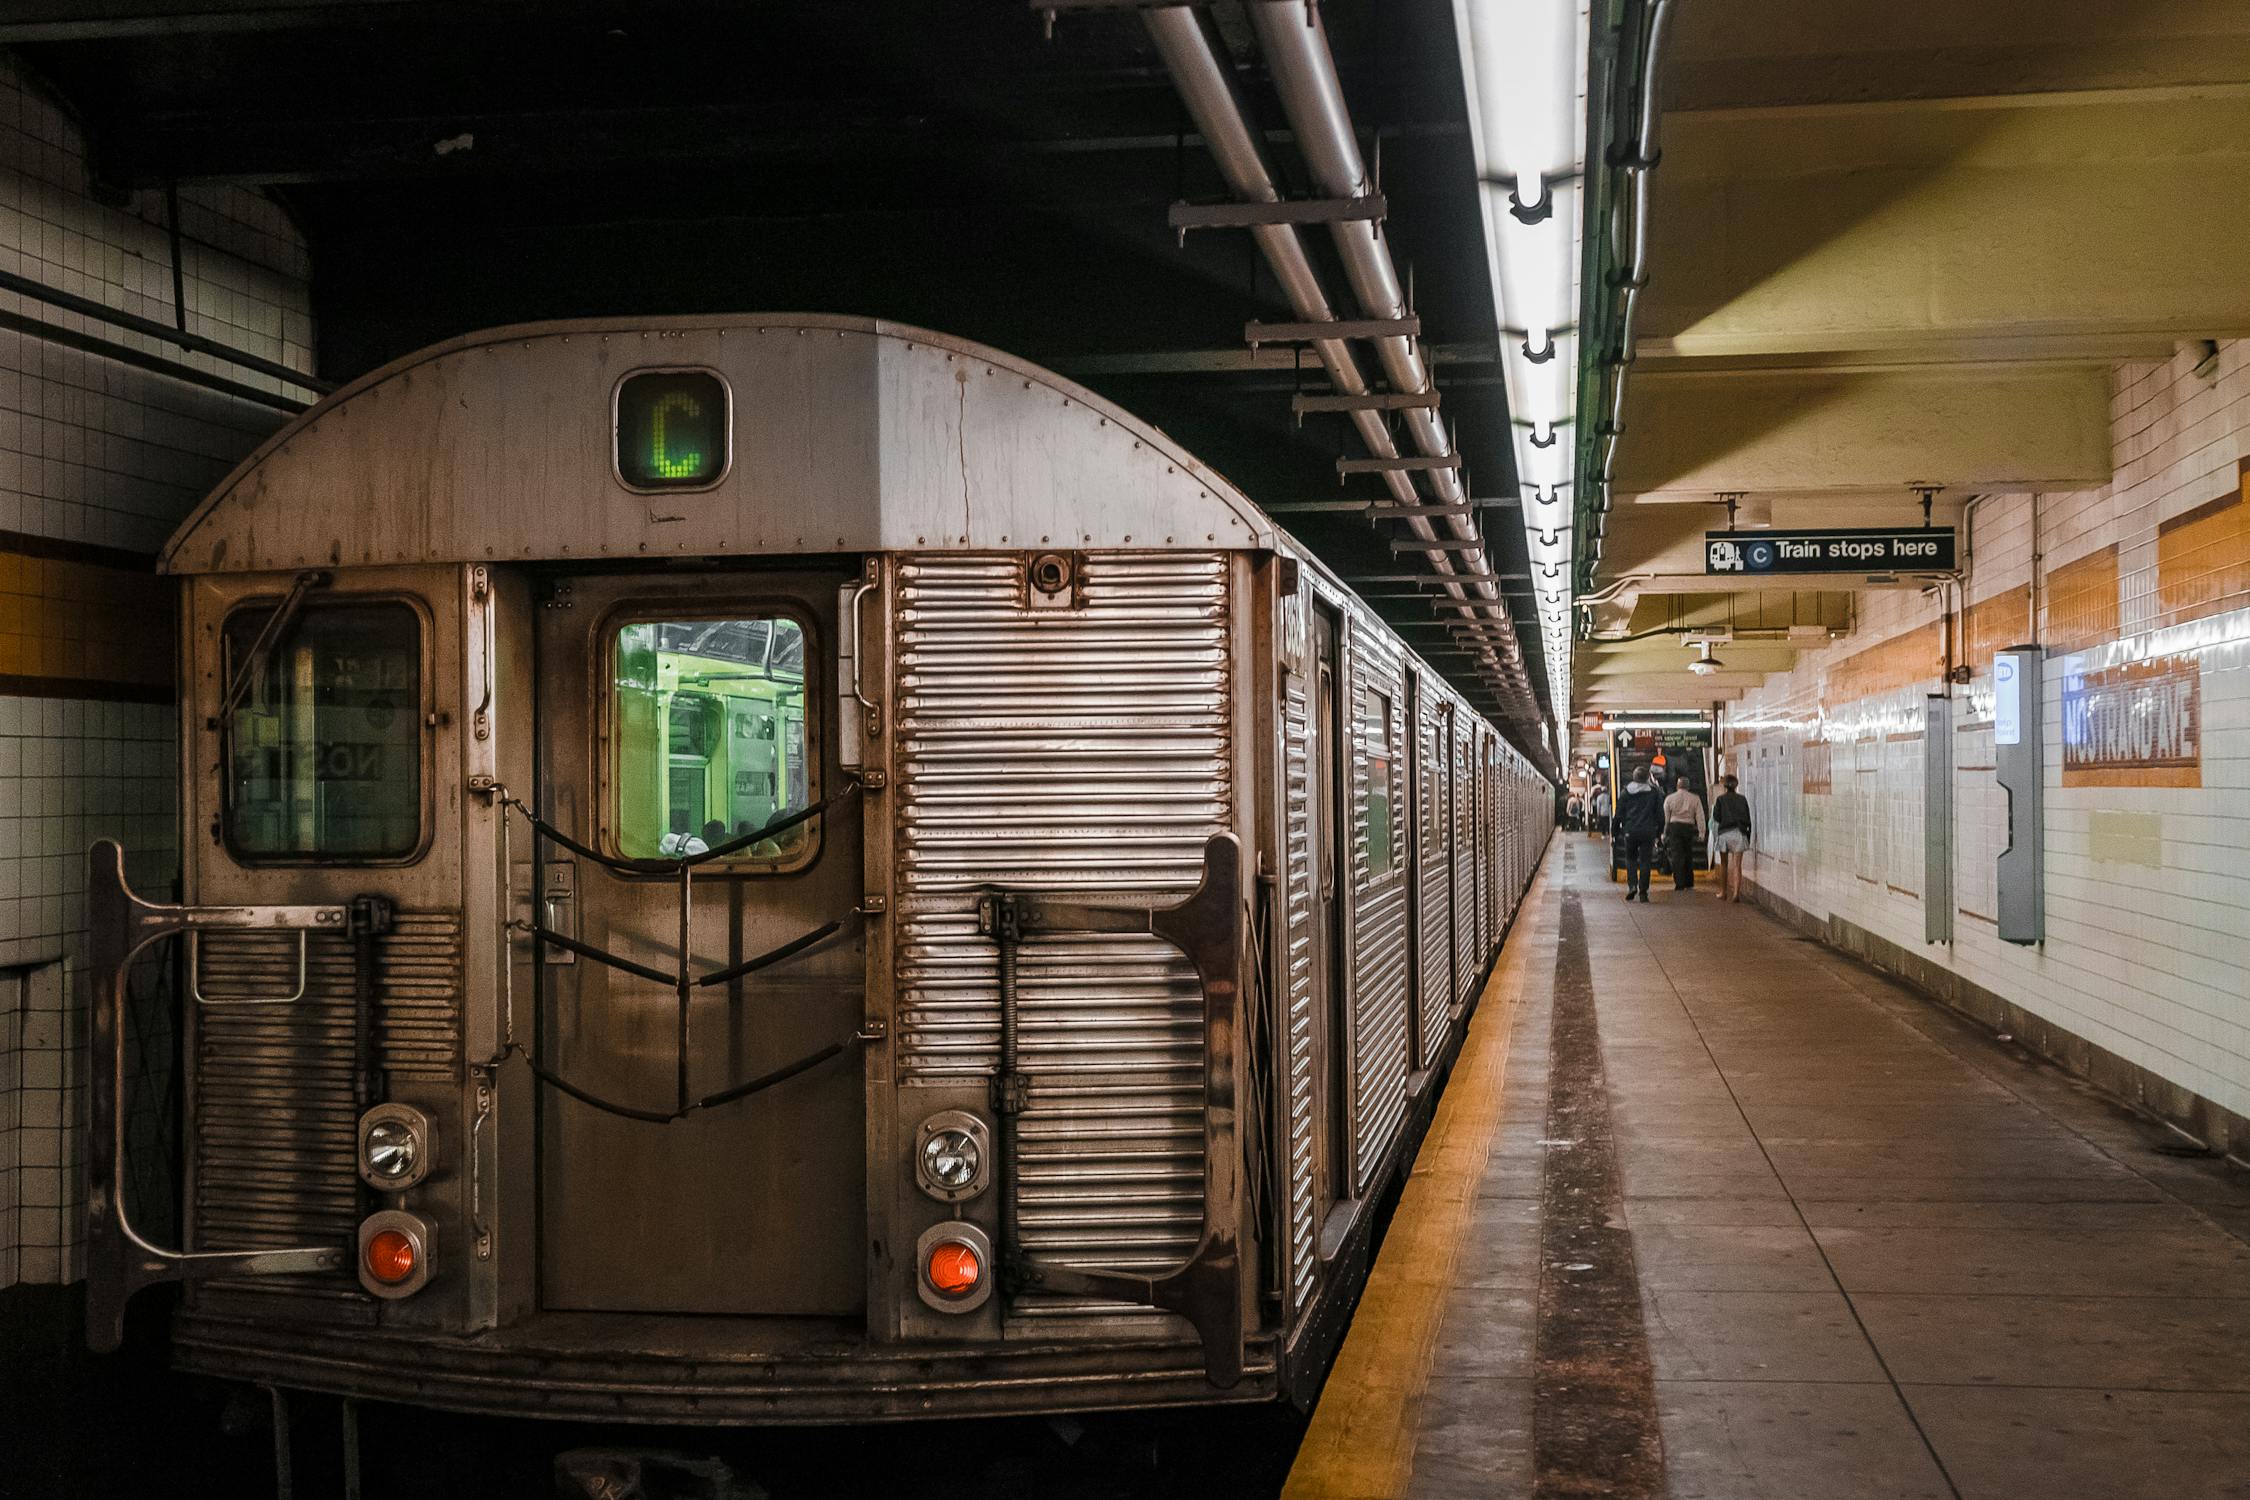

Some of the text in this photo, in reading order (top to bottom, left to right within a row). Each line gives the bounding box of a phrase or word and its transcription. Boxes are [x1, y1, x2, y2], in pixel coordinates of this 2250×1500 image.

[652, 391, 701, 479] C
[1752, 538, 1938, 563] C Train stops here
[1634, 728, 1652, 738] Exit
[2066, 679, 2194, 764] NOSTRAND AVE
